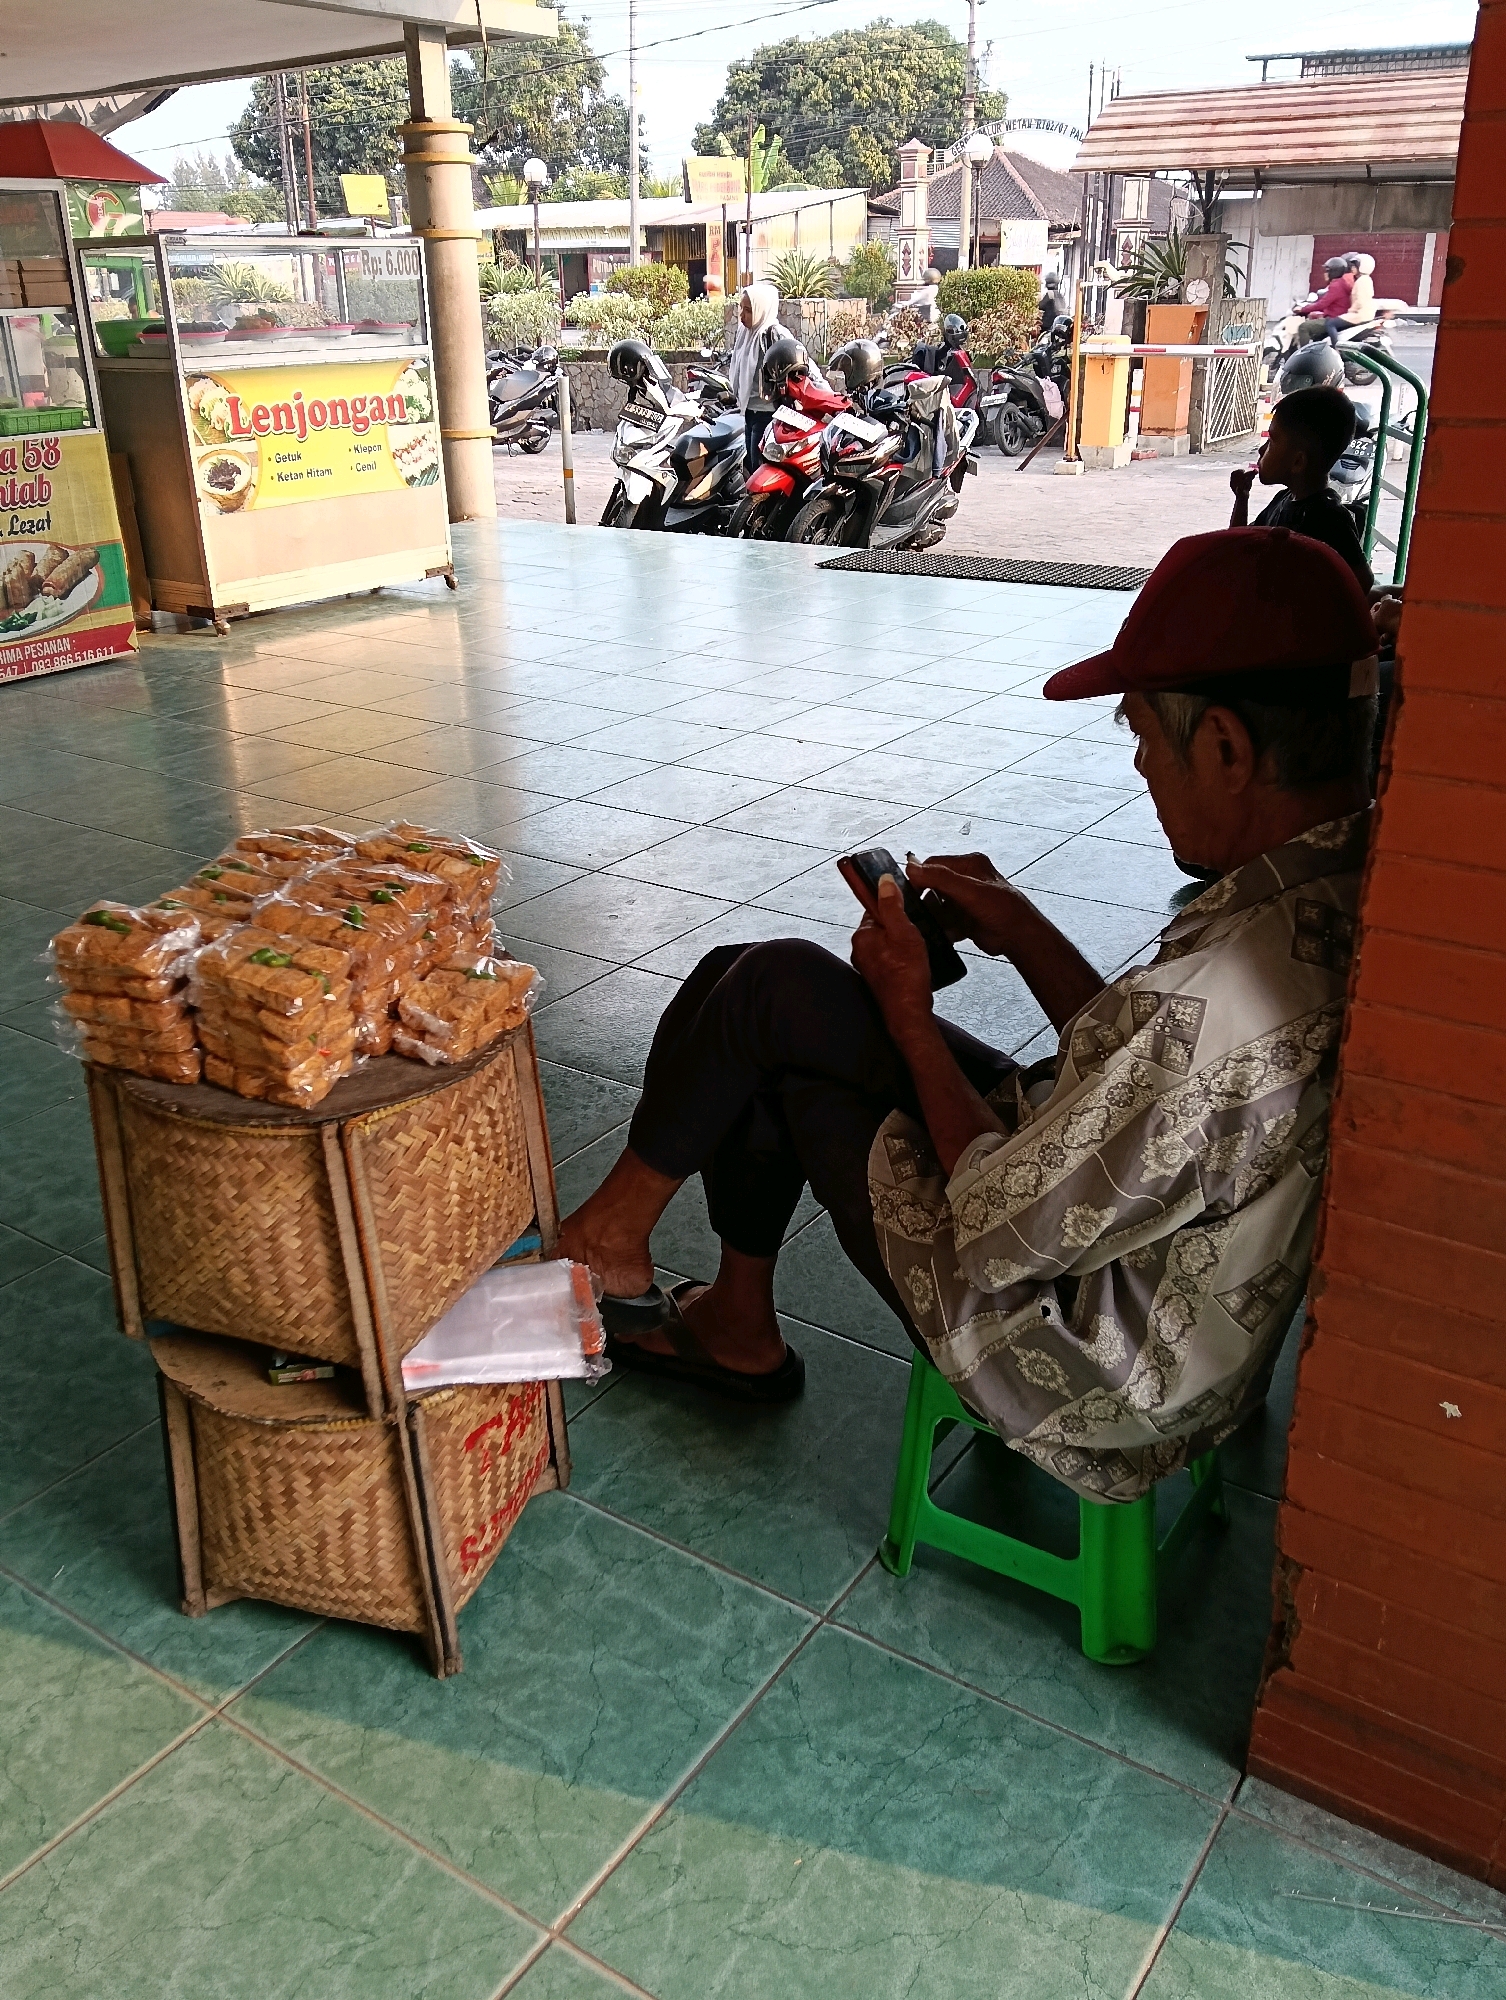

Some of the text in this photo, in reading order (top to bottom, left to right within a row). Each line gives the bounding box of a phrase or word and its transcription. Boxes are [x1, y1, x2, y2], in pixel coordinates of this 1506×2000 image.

[709, 225, 720, 235] RM
[386, 249, 418, 276] 6.000
[225, 391, 407, 439] Lenjongan
[24, 437, 61, 470] 58
[275, 451, 302, 463] Getuk
[277, 468, 333, 482] Ketan Hitam
[355, 460, 377, 472] Cenil
[8, 510, 52, 536] Lezat
[25, 638, 71, 660] PESANAN
